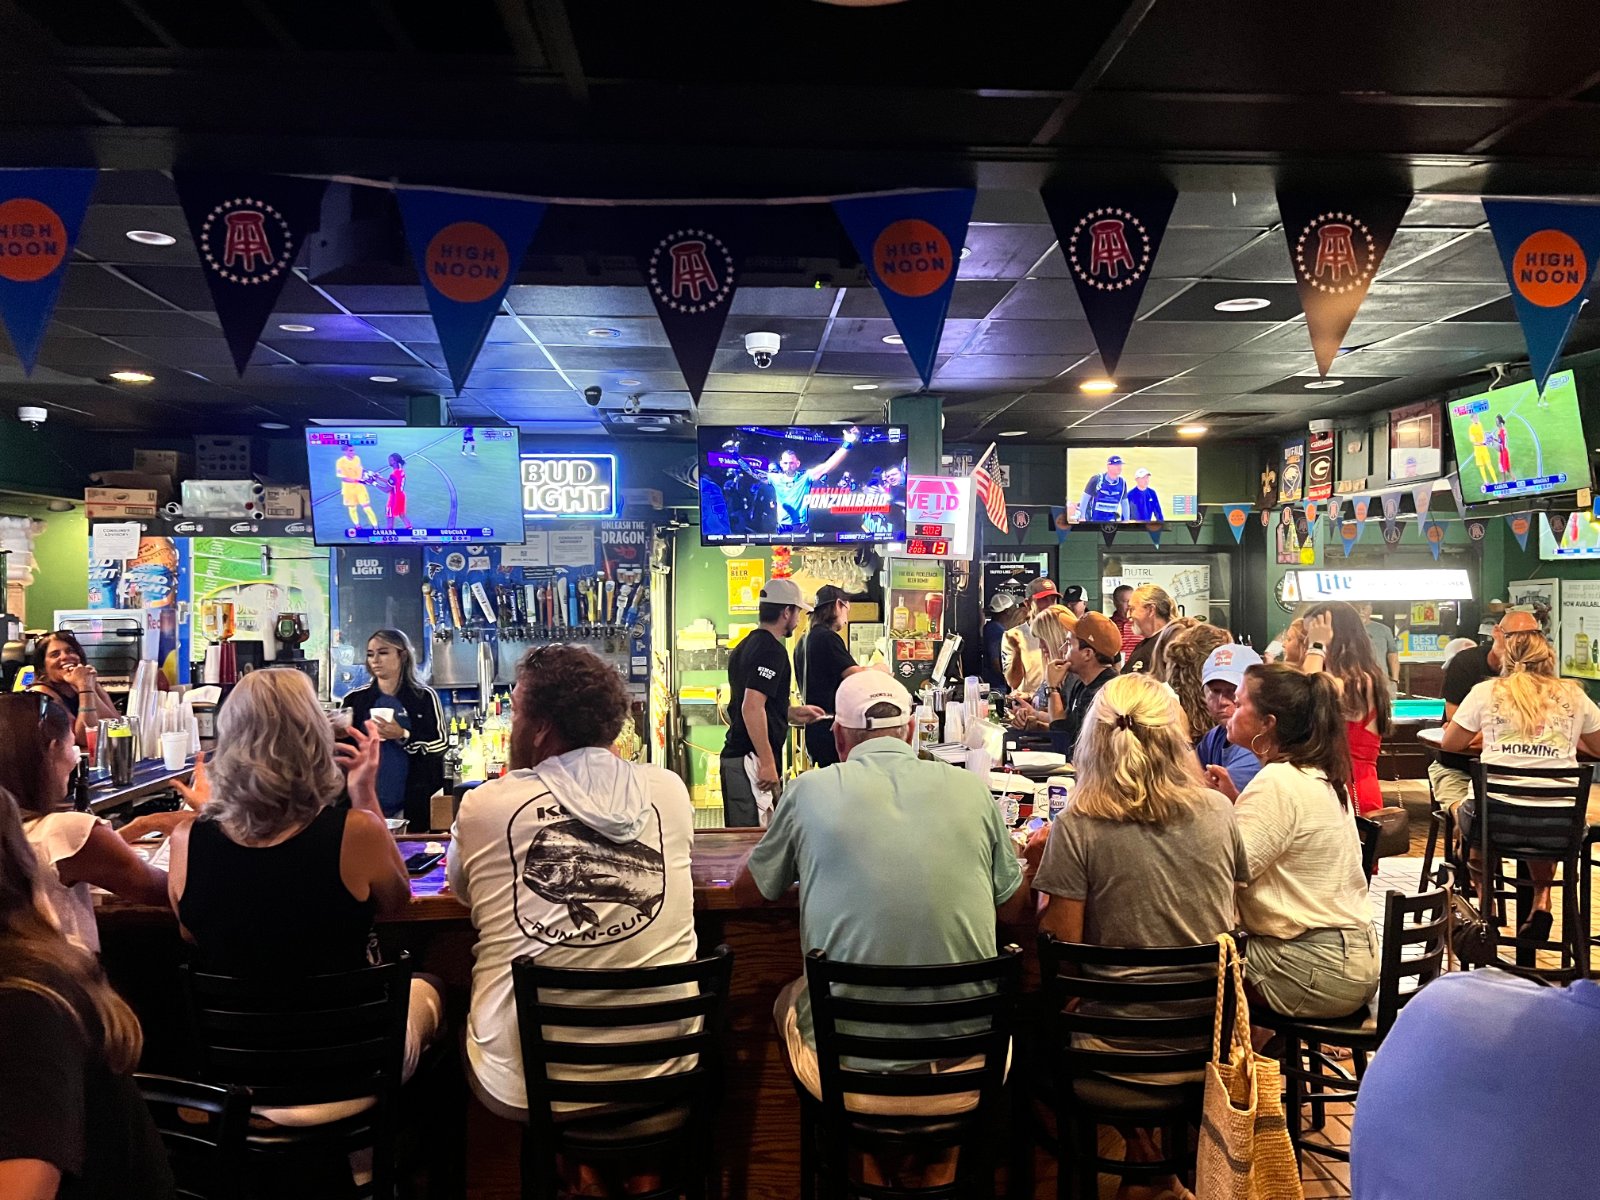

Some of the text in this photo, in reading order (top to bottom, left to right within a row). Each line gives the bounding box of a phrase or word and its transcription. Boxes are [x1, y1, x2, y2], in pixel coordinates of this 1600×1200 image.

[441, 244, 496, 261] HIGH
[886, 240, 938, 258] HIGH
[883, 256, 945, 275] NOON
[1526, 252, 1575, 267] HIGH
[434, 261, 499, 279] NOON
[1521, 269, 1579, 284] NOON
[520, 459, 596, 487] BUD
[523, 484, 611, 513] IGHT
[802, 493, 892, 508] PONZINIBBIO
[602, 521, 645, 530] UNLEASH THE
[602, 531, 645, 545] DRAGON
[932, 542, 946, 554] 13
[356, 559, 379, 567] BUD
[352, 567, 383, 575] LIGHT
[1316, 572, 1352, 595] Lite
[1575, 600, 1600, 608] AVAILABL
[1413, 634, 1438, 645] BEST
[1502, 743, 1560, 759] MORNING
